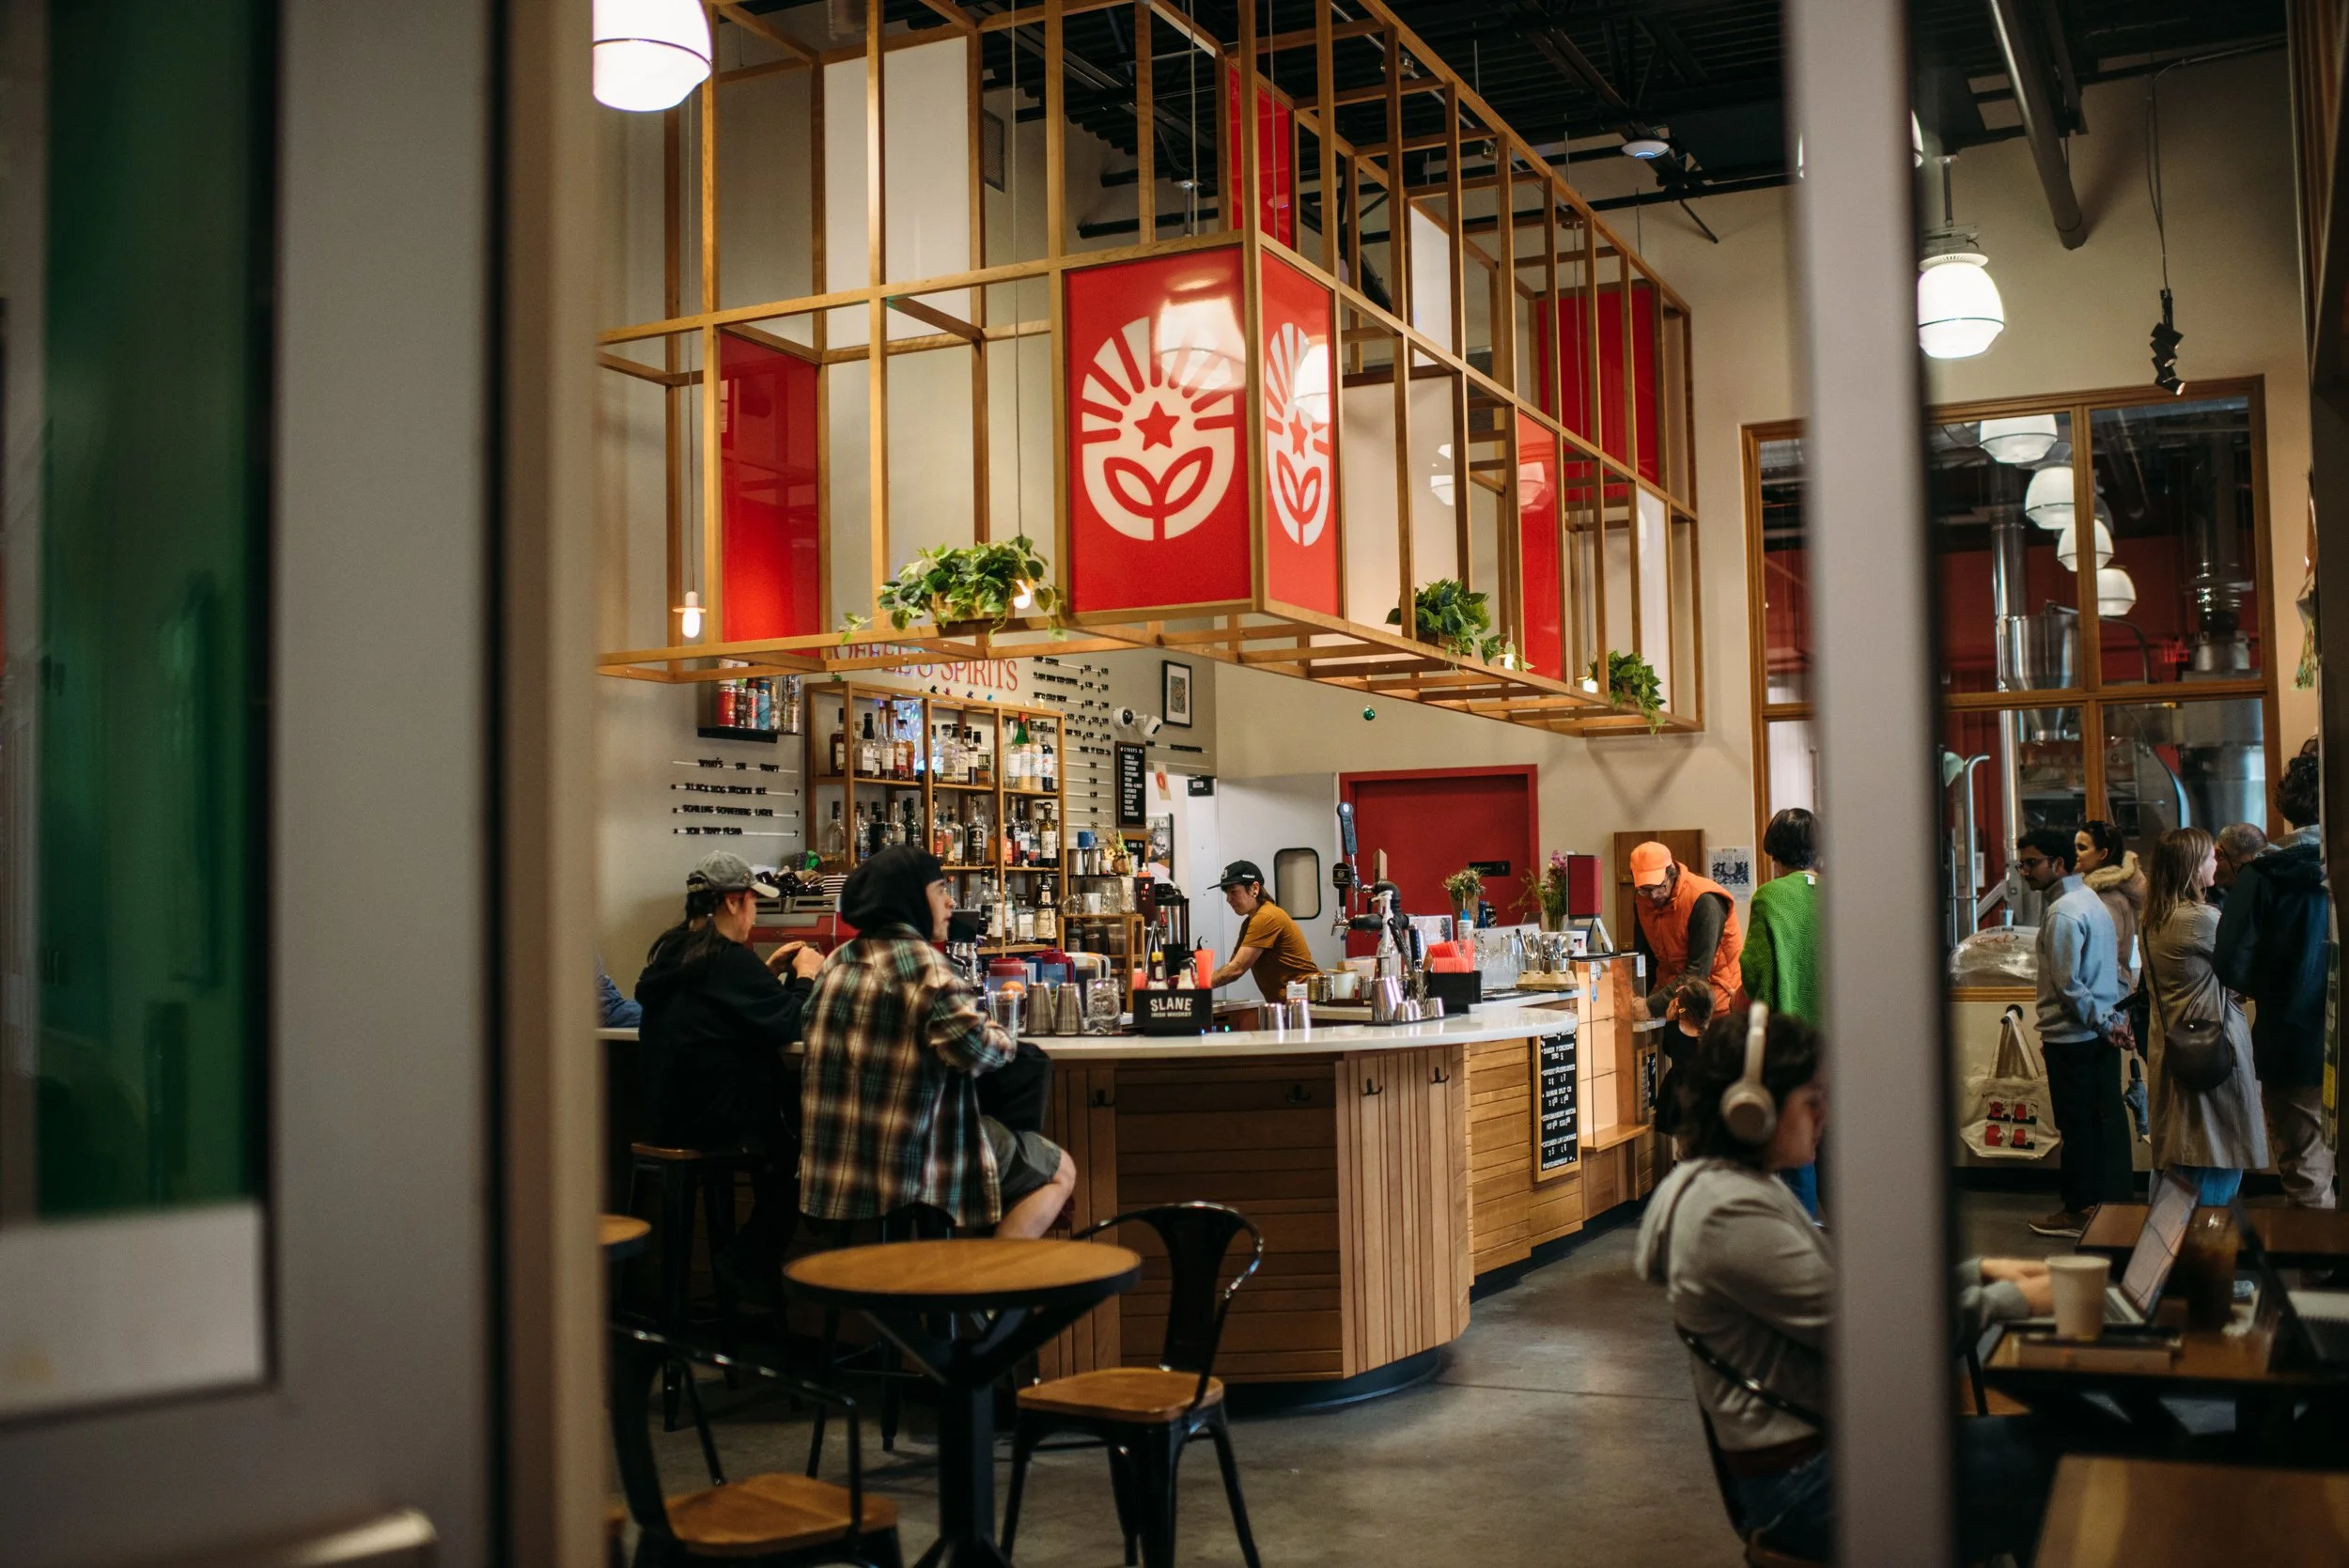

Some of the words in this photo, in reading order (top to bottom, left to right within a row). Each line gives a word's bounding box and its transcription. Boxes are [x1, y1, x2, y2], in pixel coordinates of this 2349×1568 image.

[941, 659, 1019, 691] SPIRITS
[698, 757, 723, 768] WHAT'S
[735, 762, 747, 770] ON
[684, 783, 709, 792] BLACK
[710, 784, 726, 794] HOG
[727, 785, 753, 795] BROWN
[754, 808, 773, 817] LAGER
[685, 827, 700, 835] VON
[1149, 997, 1193, 1012] SLANE
